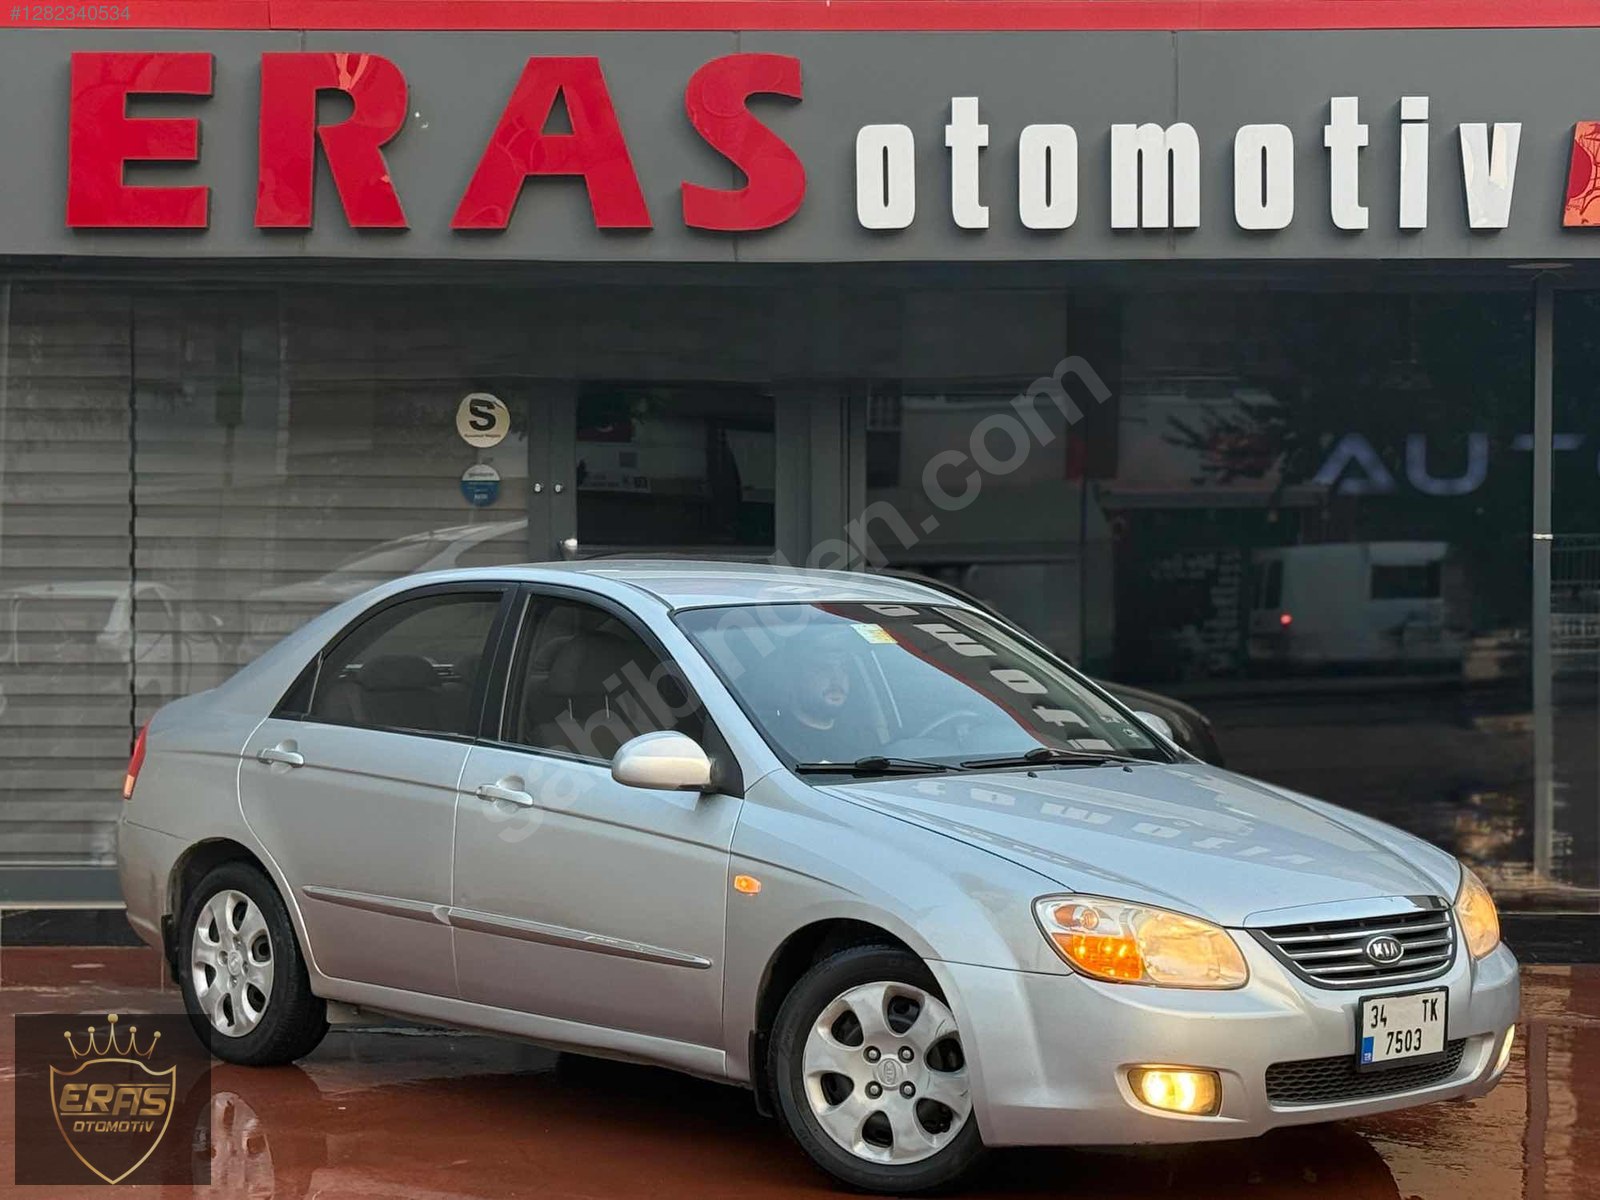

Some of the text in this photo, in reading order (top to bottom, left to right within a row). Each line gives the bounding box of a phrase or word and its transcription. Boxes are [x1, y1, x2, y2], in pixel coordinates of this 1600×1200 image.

[66, 51, 1522, 232] ERAS otomotiv
[1370, 941, 1399, 959] KIA
[1370, 997, 1439, 1029] 34 TK
[1385, 1027, 1422, 1056] 7503
